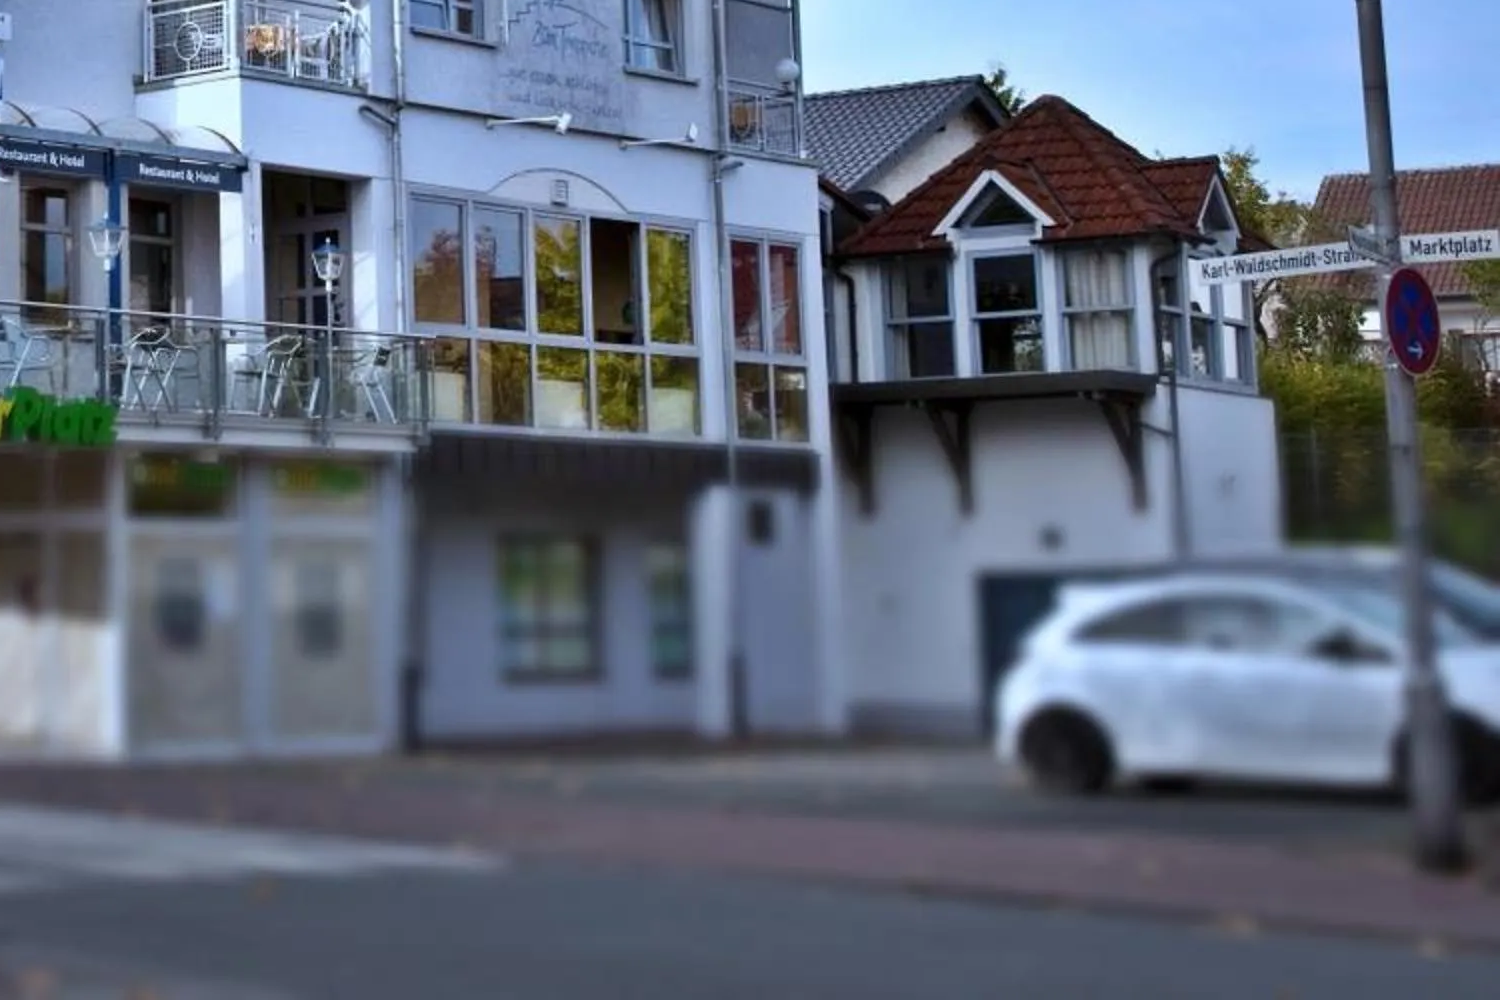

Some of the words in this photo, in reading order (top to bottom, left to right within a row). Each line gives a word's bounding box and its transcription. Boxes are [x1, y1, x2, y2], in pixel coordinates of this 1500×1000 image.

[49, 151, 58, 167] &
[59, 153, 85, 168] Hotel
[139, 162, 185, 181] Restaurant
[186, 171, 194, 184] &
[195, 171, 221, 185] Hotel
[1409, 235, 1493, 257] Marktplatz
